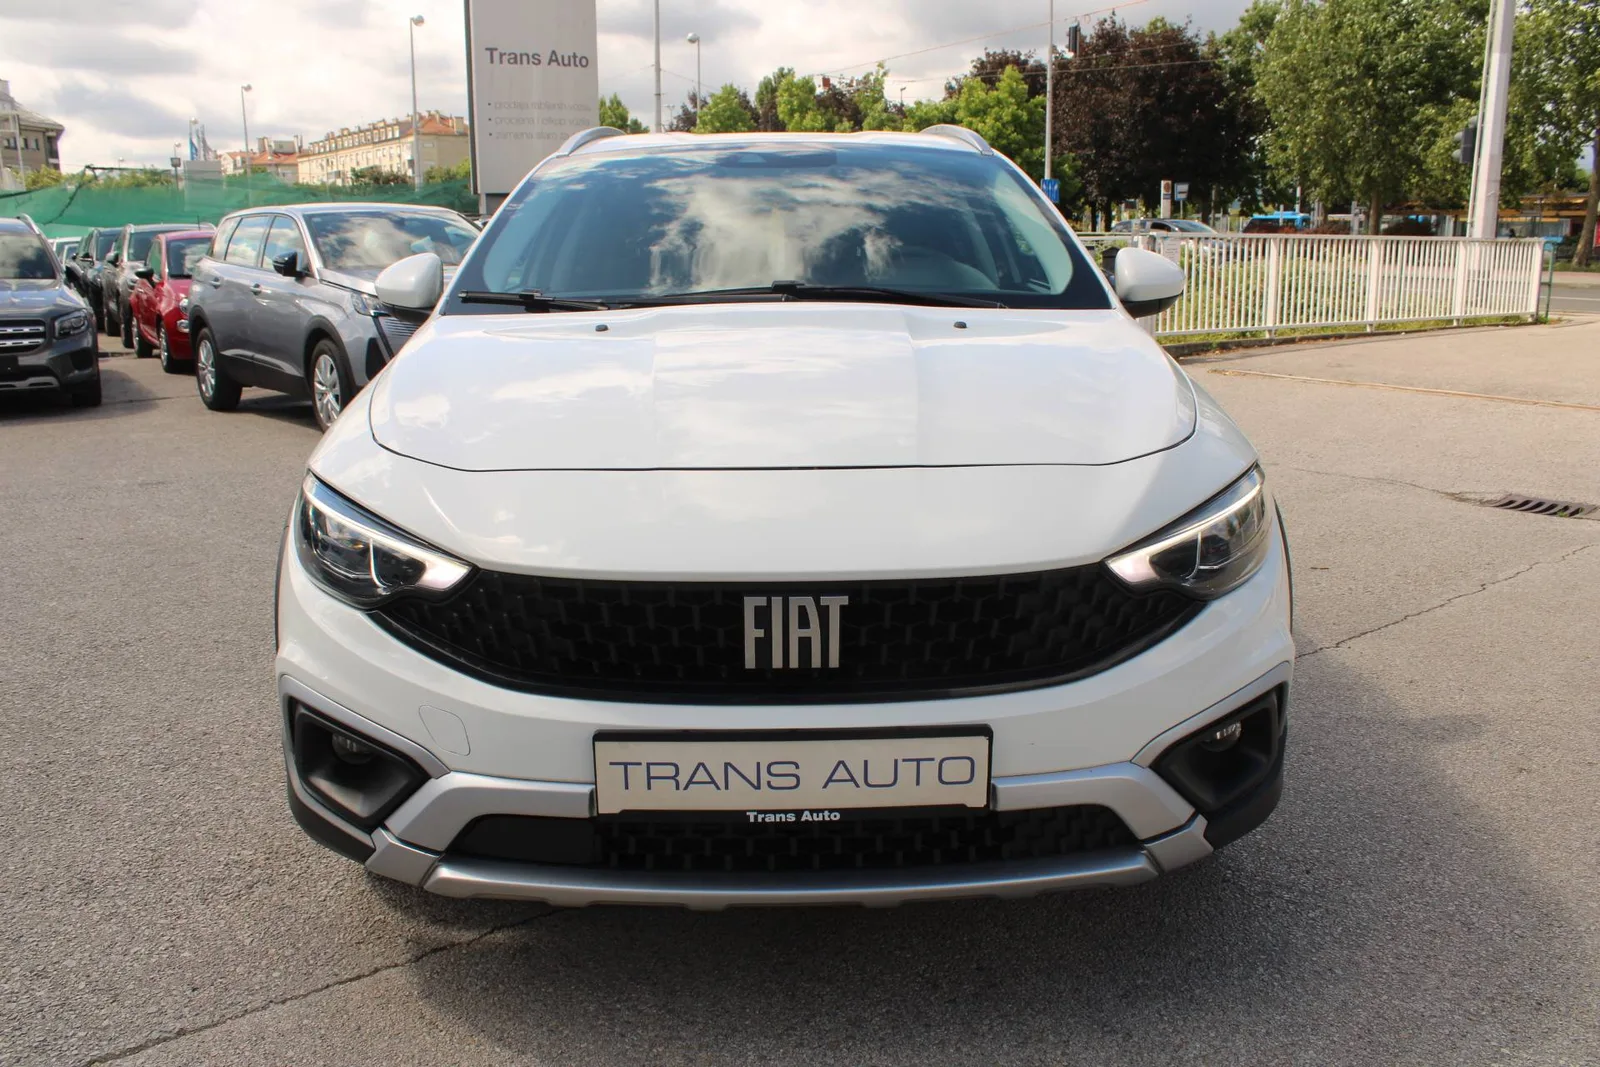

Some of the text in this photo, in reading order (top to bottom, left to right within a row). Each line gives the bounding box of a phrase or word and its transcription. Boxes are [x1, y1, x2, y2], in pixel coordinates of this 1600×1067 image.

[484, 47, 589, 69] Trans Auto
[743, 595, 849, 669] FIAT
[609, 755, 976, 791] TRANS AUTO
[746, 810, 841, 823] Trans Auto
